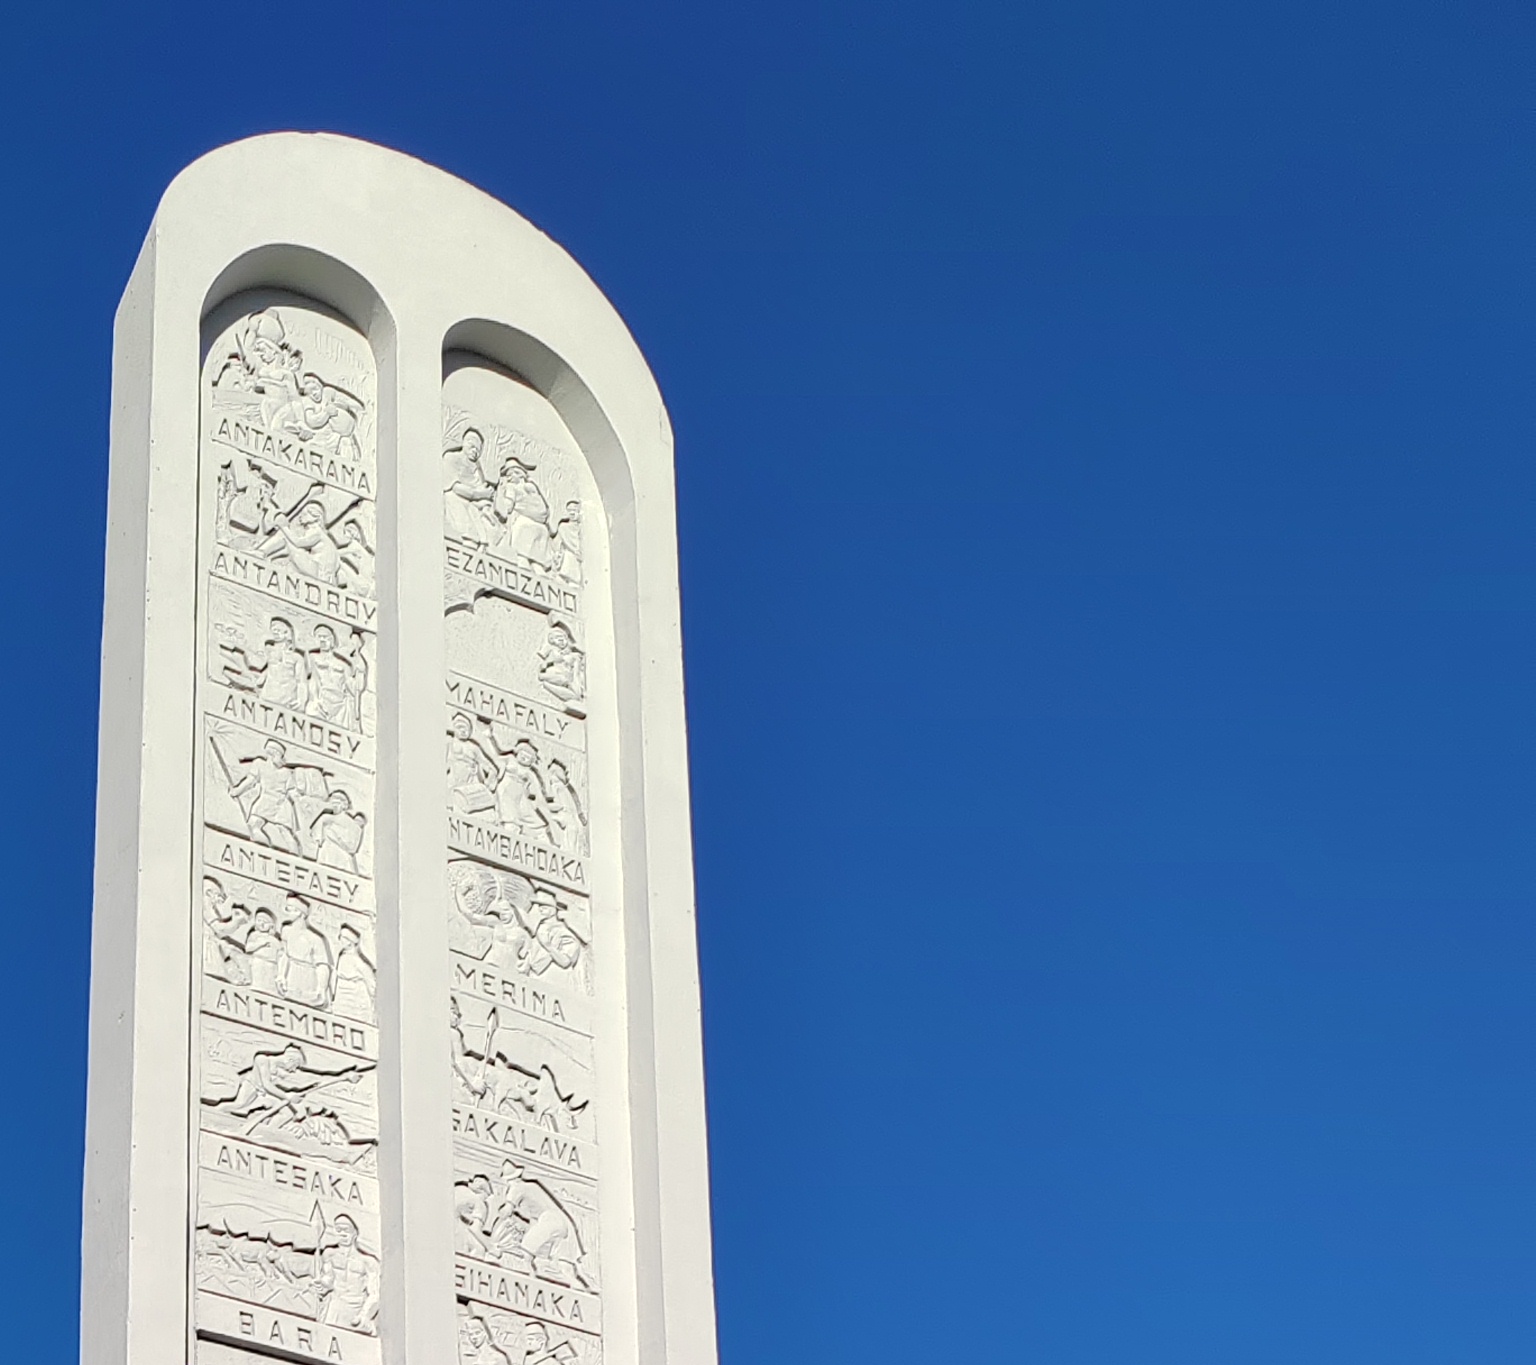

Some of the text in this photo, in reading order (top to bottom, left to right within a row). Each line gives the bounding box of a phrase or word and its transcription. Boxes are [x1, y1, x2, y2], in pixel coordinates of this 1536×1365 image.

[218, 418, 371, 494] ANTAKARANA
[445, 545, 577, 614] EZANOZANO
[223, 694, 361, 759] ANTANOSY
[445, 679, 571, 740] MAHAFALY
[221, 843, 359, 903] ANTEFASY
[448, 816, 585, 884] NTAMBAHOAKA
[216, 989, 366, 1051] ANTEMORO
[455, 962, 566, 1022] MERINA
[452, 1108, 581, 1168] SAKALAVA
[216, 1145, 364, 1205] ANTESAKA
[455, 1264, 584, 1323] SIHANAKA
[239, 1310, 343, 1361] BARA
